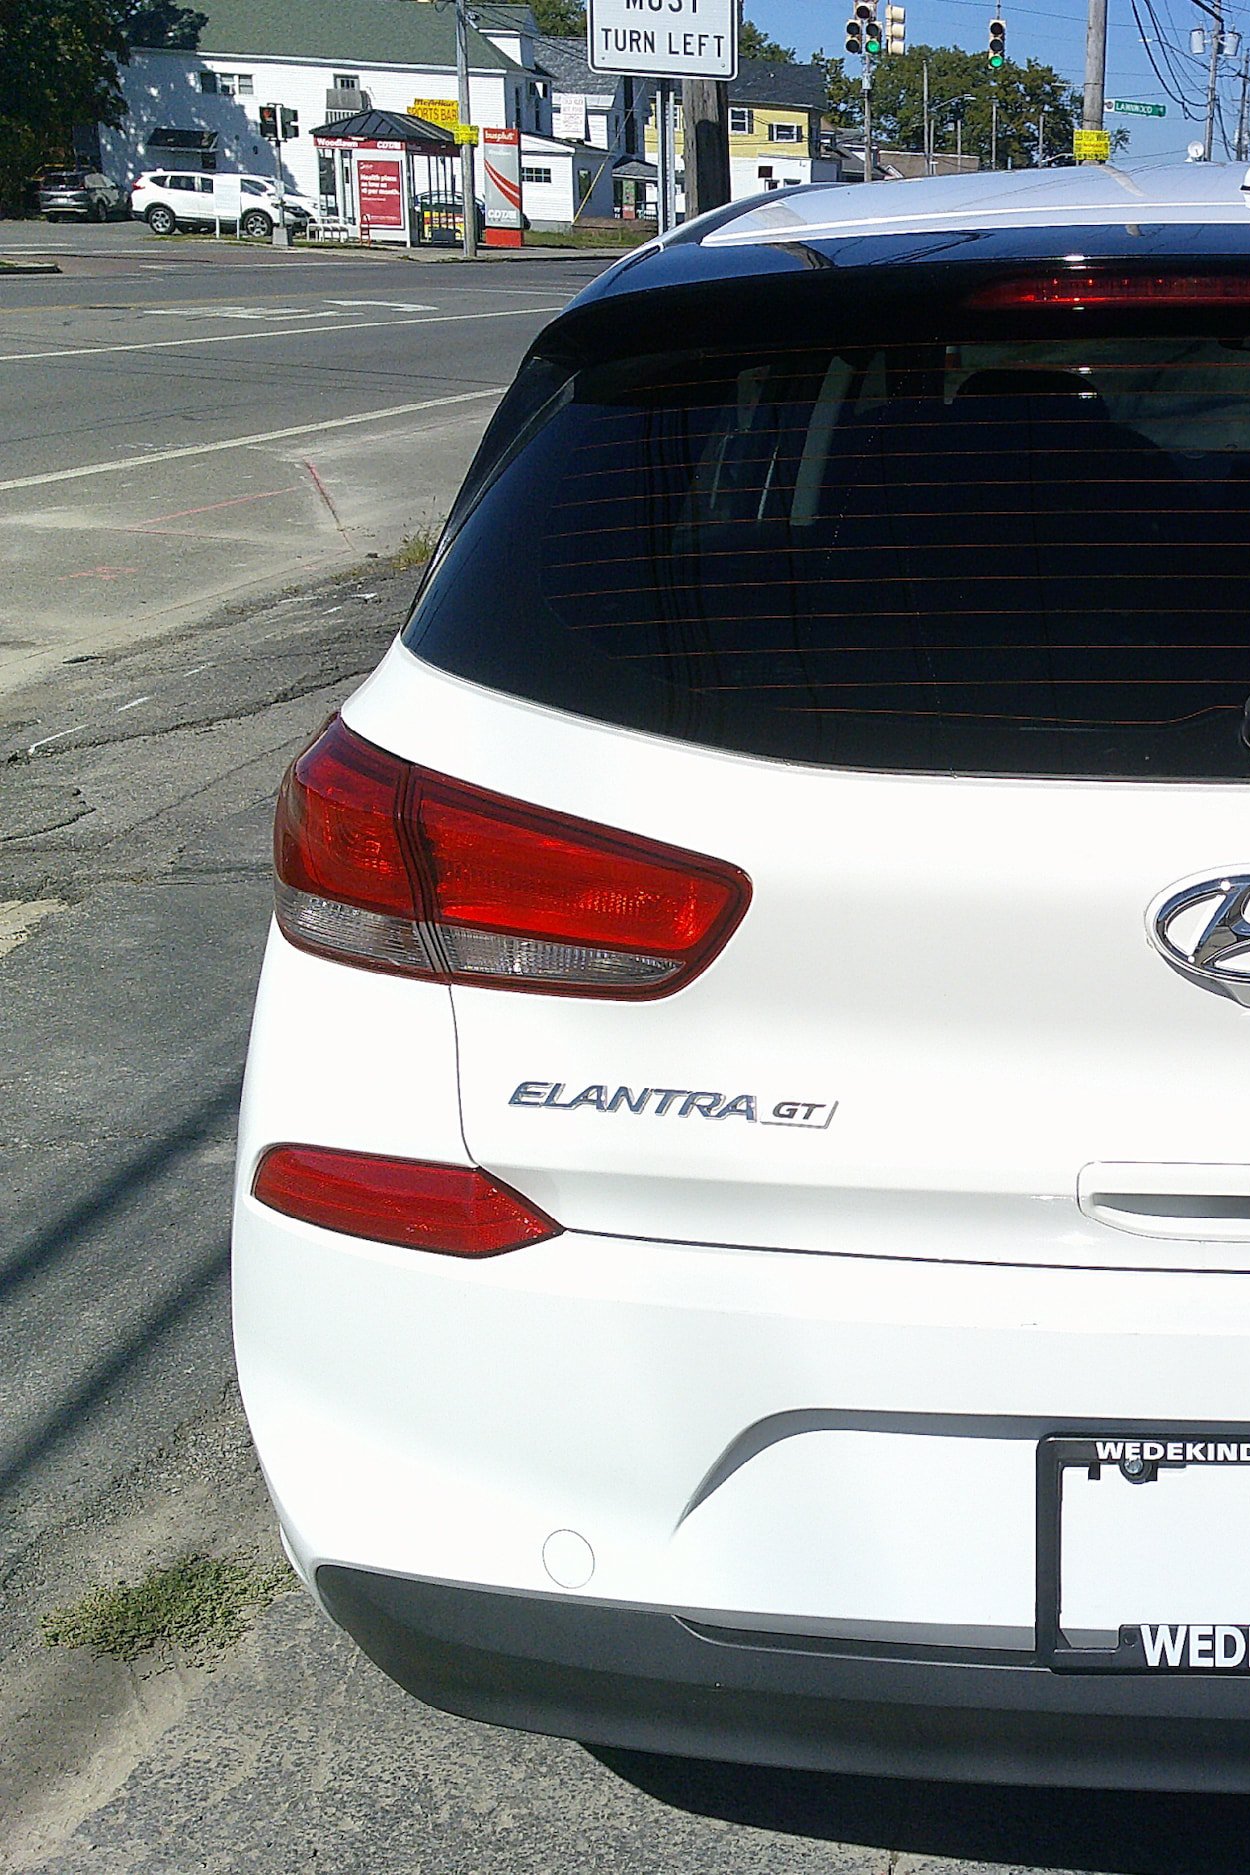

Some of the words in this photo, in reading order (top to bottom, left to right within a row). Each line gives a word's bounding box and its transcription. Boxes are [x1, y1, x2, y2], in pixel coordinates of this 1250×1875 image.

[601, 28, 656, 54] TURN
[668, 32, 725, 58] LEFT
[440, 108, 458, 121] BAR
[317, 138, 359, 148] Woodlawn
[360, 173, 380, 181] Health
[508, 1081, 758, 1123] ELANTRA
[772, 1101, 827, 1121] GT
